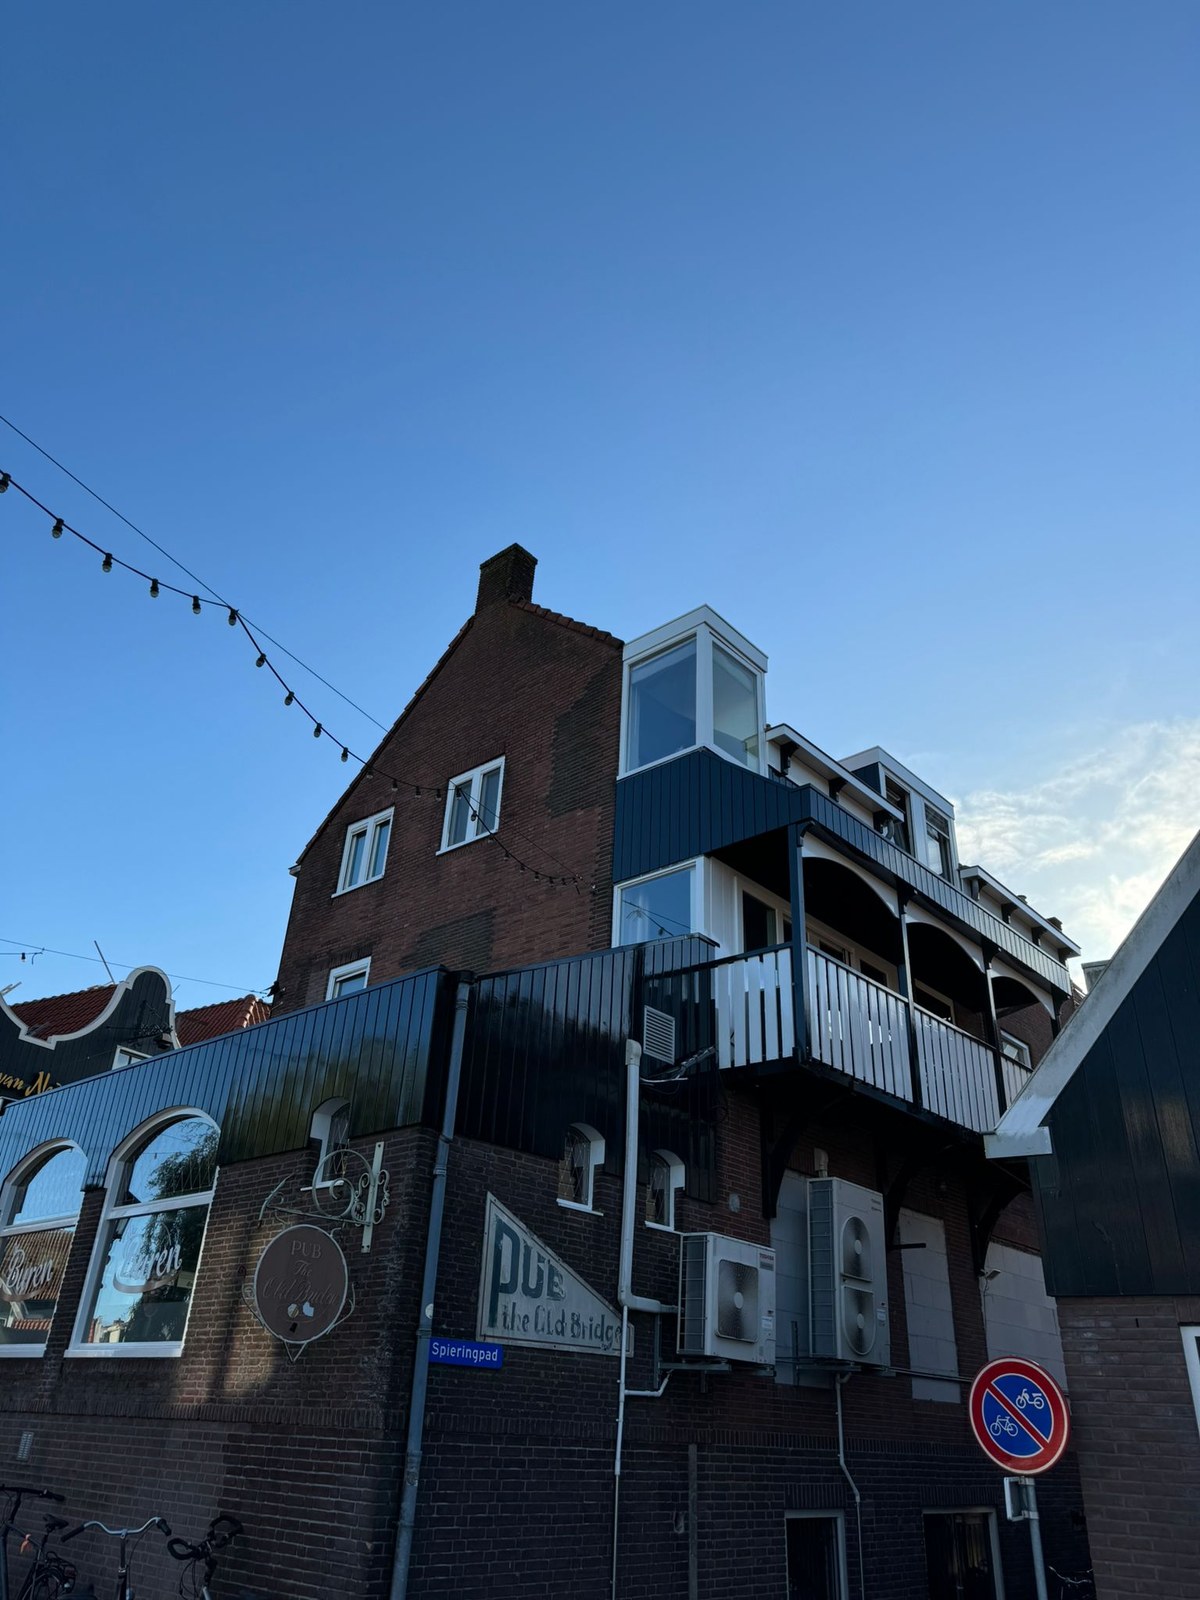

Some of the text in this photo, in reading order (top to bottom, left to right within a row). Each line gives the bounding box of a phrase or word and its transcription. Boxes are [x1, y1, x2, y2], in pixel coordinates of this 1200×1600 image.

[291, 1240, 322, 1259] PUB
[293, 1260, 313, 1277] The
[502, 1302, 622, 1350] the Old Bridge
[432, 1342, 498, 1363] Spieringpad
